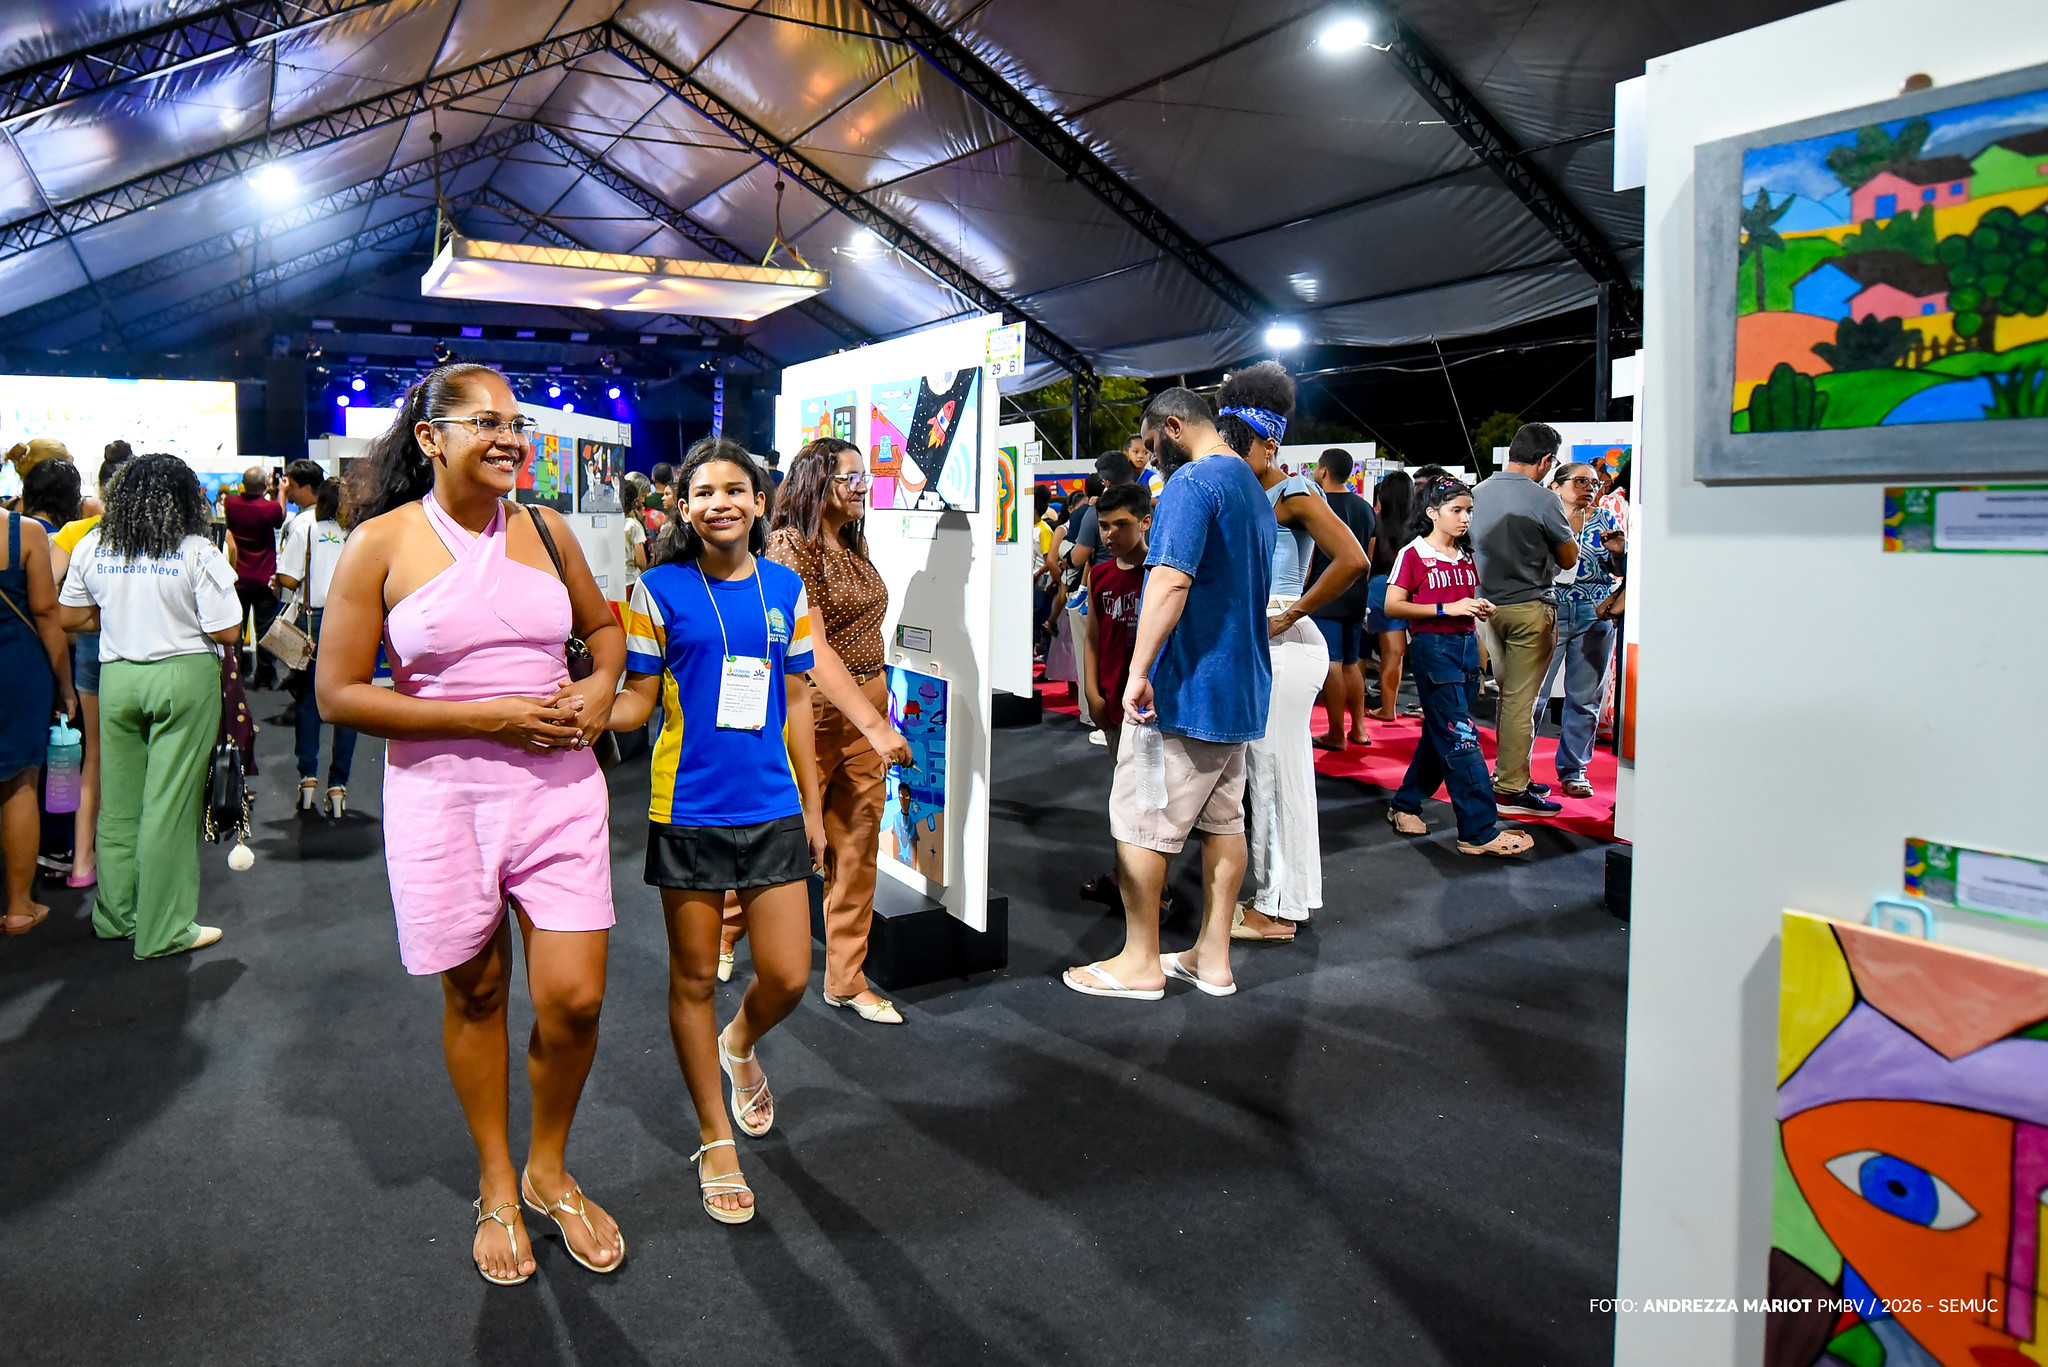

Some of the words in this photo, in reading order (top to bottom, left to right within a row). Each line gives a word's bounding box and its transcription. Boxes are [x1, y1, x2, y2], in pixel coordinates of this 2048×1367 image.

[991, 363, 1002, 376] 29
[150, 563, 179, 577] Neve
[1453, 568, 1464, 586] LE
[1454, 741, 1477, 751] STITC
